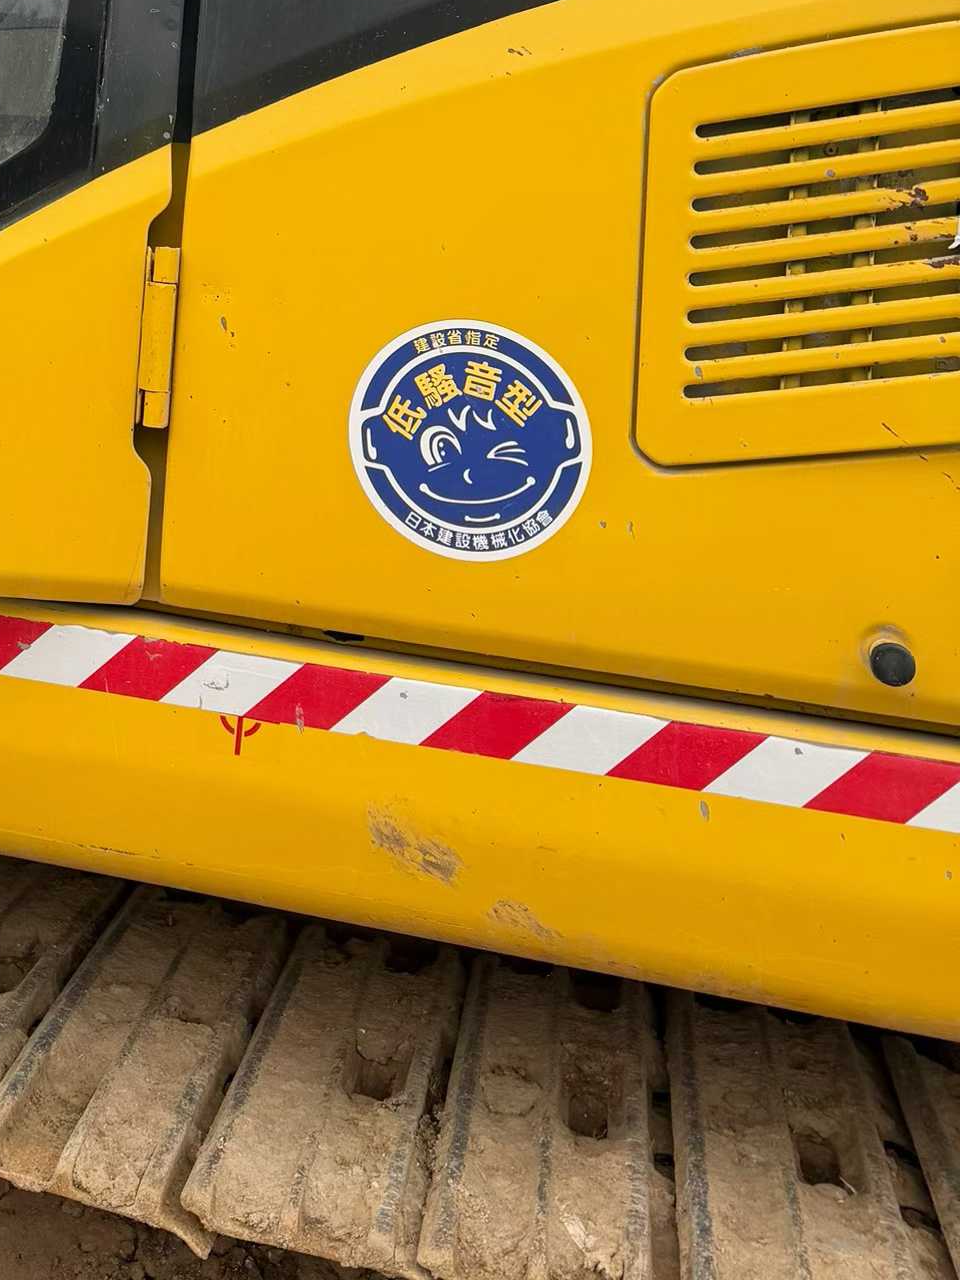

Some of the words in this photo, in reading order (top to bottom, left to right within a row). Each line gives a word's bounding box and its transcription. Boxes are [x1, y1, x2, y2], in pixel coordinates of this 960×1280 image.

[413, 329, 500, 354] 建設省指定
